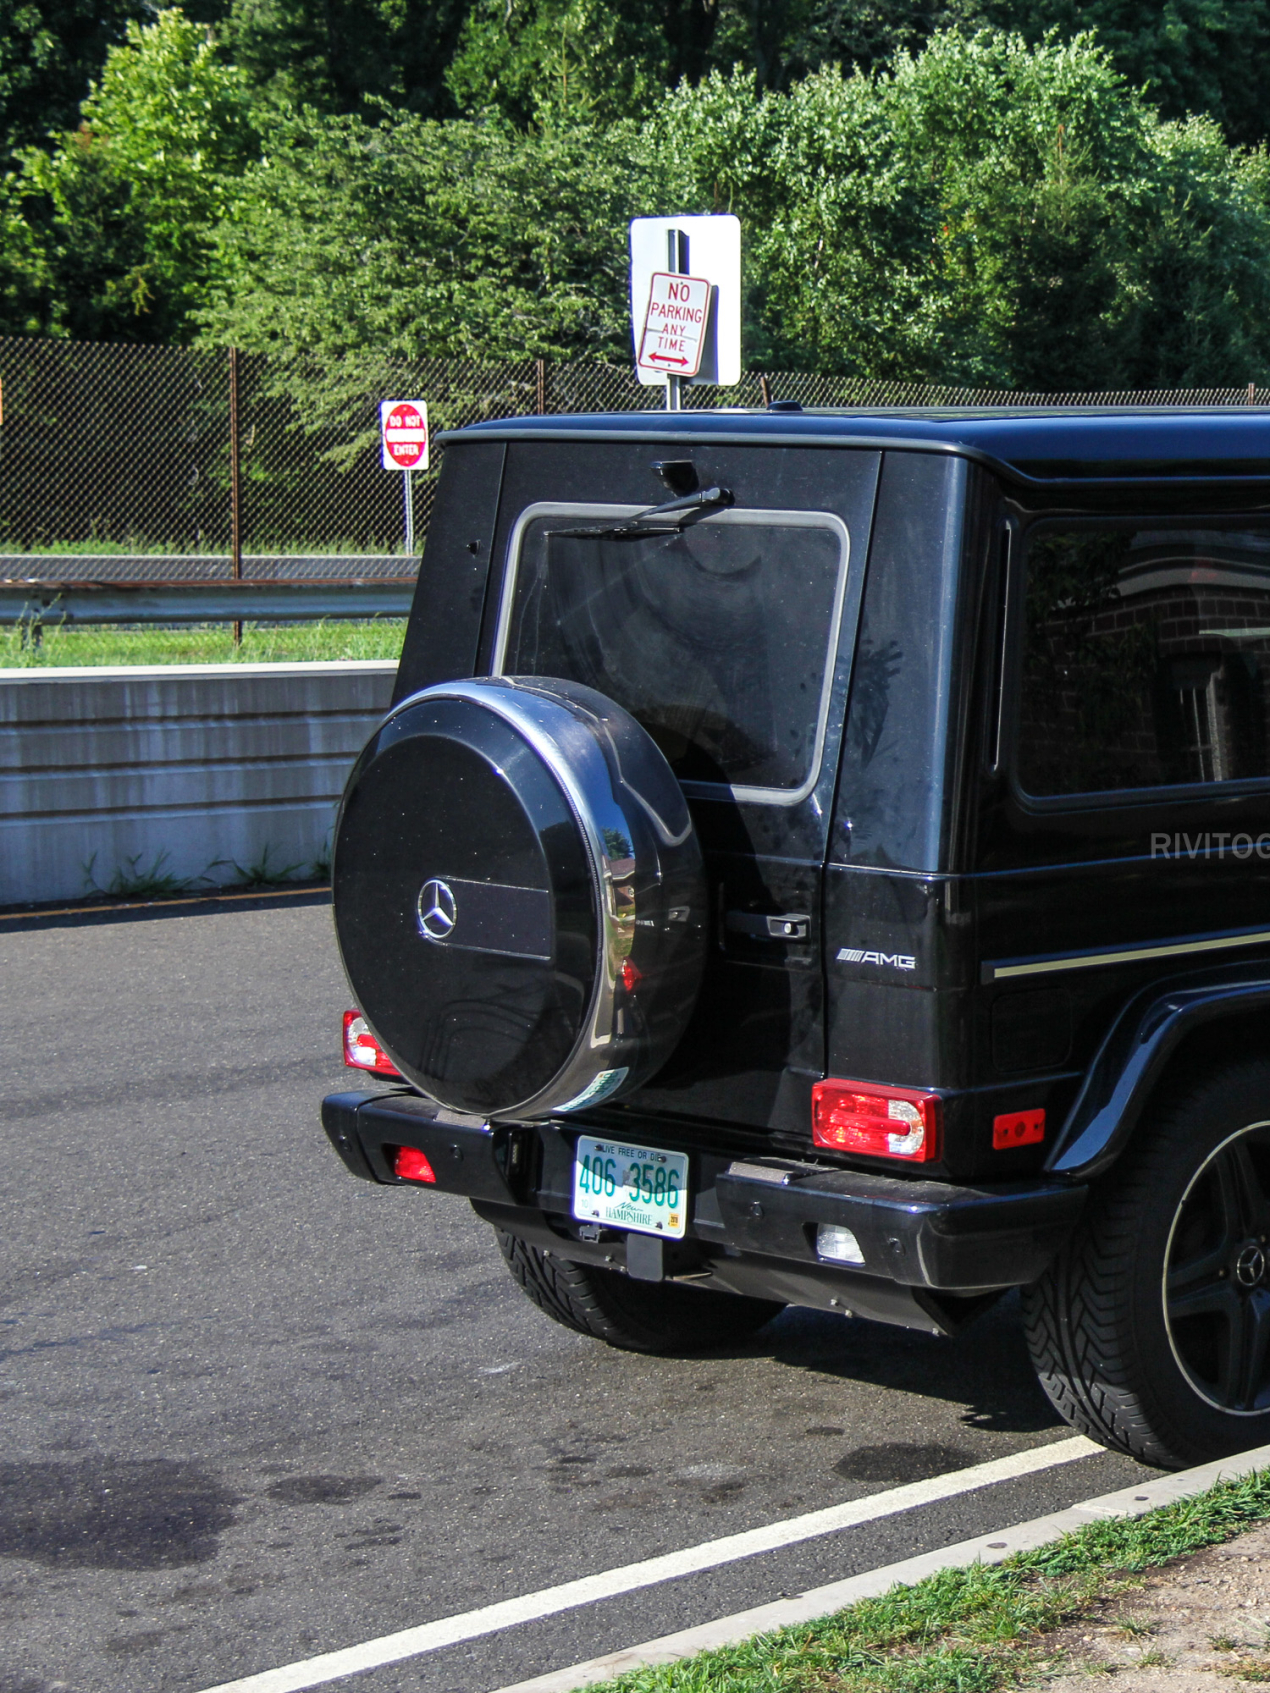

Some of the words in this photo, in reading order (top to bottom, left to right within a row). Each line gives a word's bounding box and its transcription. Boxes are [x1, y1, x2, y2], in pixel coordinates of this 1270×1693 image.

[668, 282, 690, 302] NO
[650, 302, 702, 324] PARKING
[662, 322, 686, 337] ANY
[658, 336, 686, 353] TIME
[389, 415, 402, 427] DO
[405, 415, 420, 427] NOT
[393, 444, 419, 456] ENTER
[861, 951, 916, 969] AMG
[602, 1145, 615, 1155] LIVE
[618, 1147, 634, 1158] FREE
[638, 1150, 647, 1159] OR
[650, 1152, 661, 1162] DIE
[579, 1154, 616, 1197] 406
[629, 1162, 680, 1209] 3586
[616, 1201, 643, 1212] New
[605, 1206, 653, 1226] HAMPSHIRE
